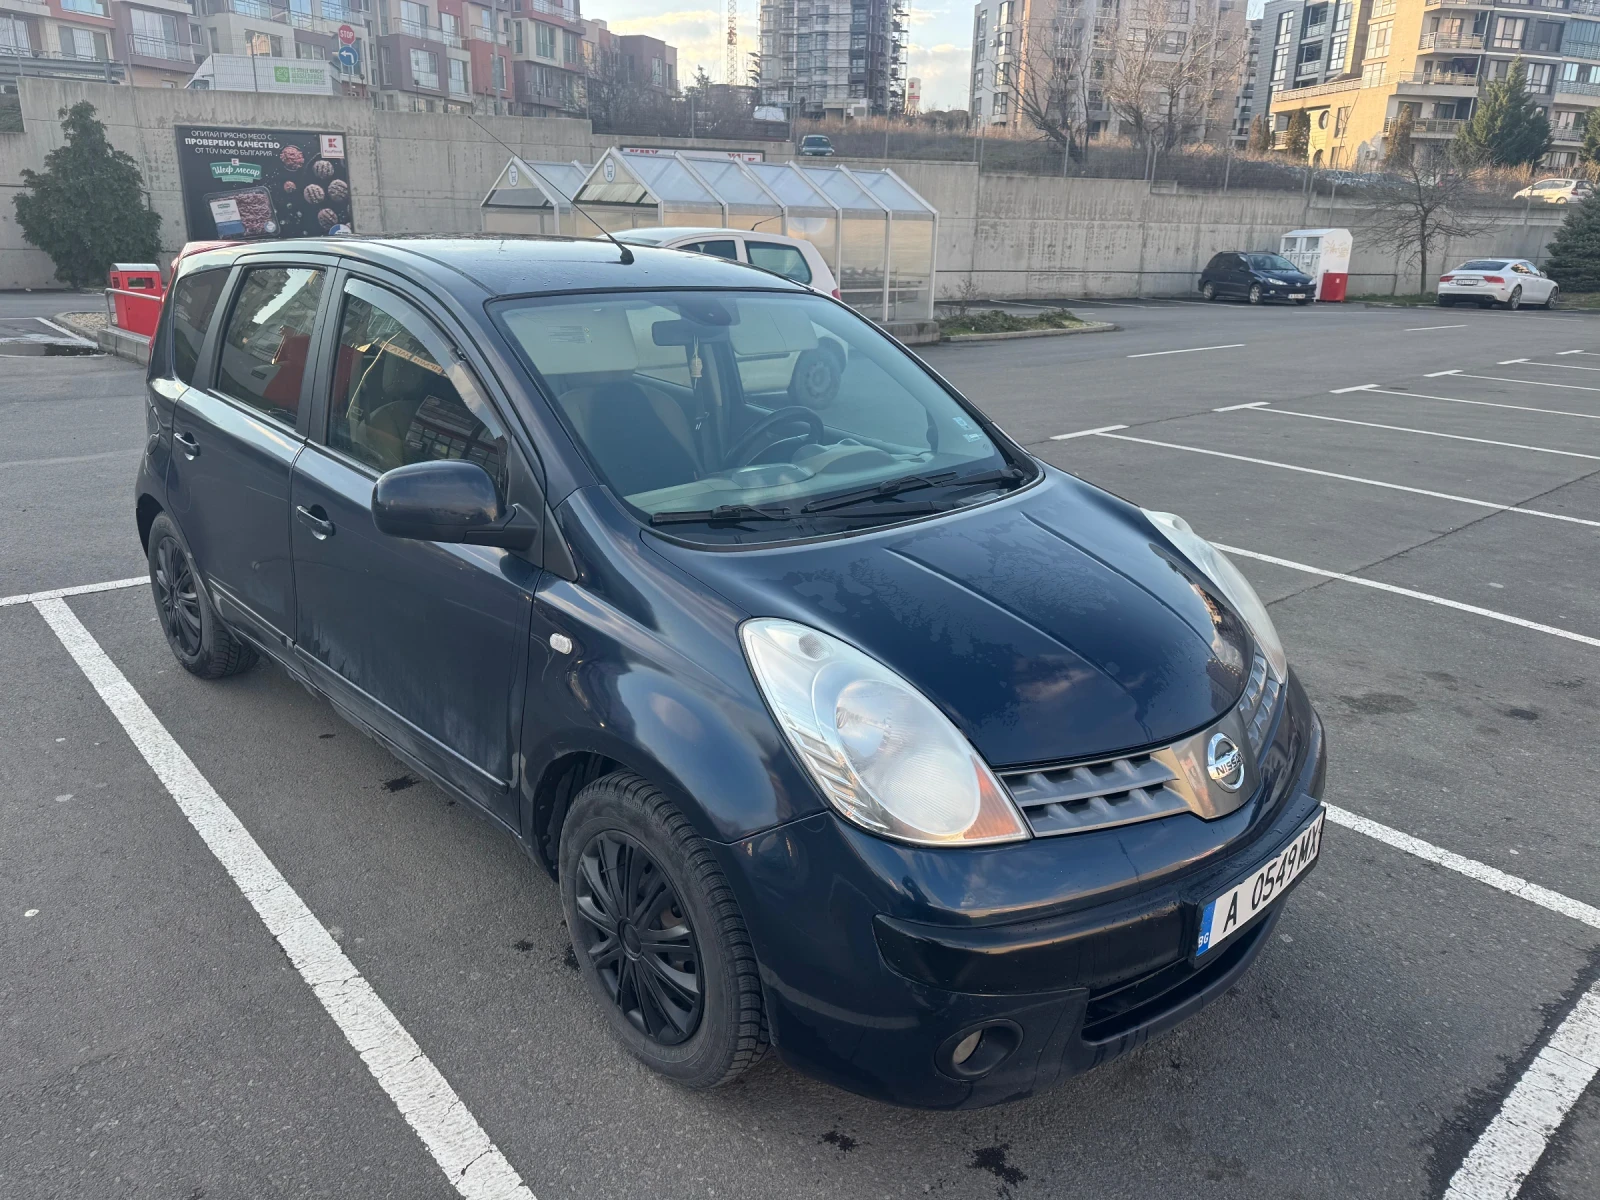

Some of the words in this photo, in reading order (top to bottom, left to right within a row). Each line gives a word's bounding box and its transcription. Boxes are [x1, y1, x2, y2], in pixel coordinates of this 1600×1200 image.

[340, 29, 354, 38] STOP
[191, 130, 219, 138] ОПИТАЙ
[220, 131, 247, 139] ПРЯСНО
[184, 138, 236, 147] ПРОВЕРЕНО
[237, 141, 280, 149] КАЧЕСТВО
[240, 149, 273, 157] БЪЛГАРИЯ
[212, 165, 233, 175] Шеф
[234, 168, 260, 177] месар
[1222, 891, 1238, 933] A
[1251, 843, 1298, 911] 0549
[1197, 932, 1210, 948] BG
